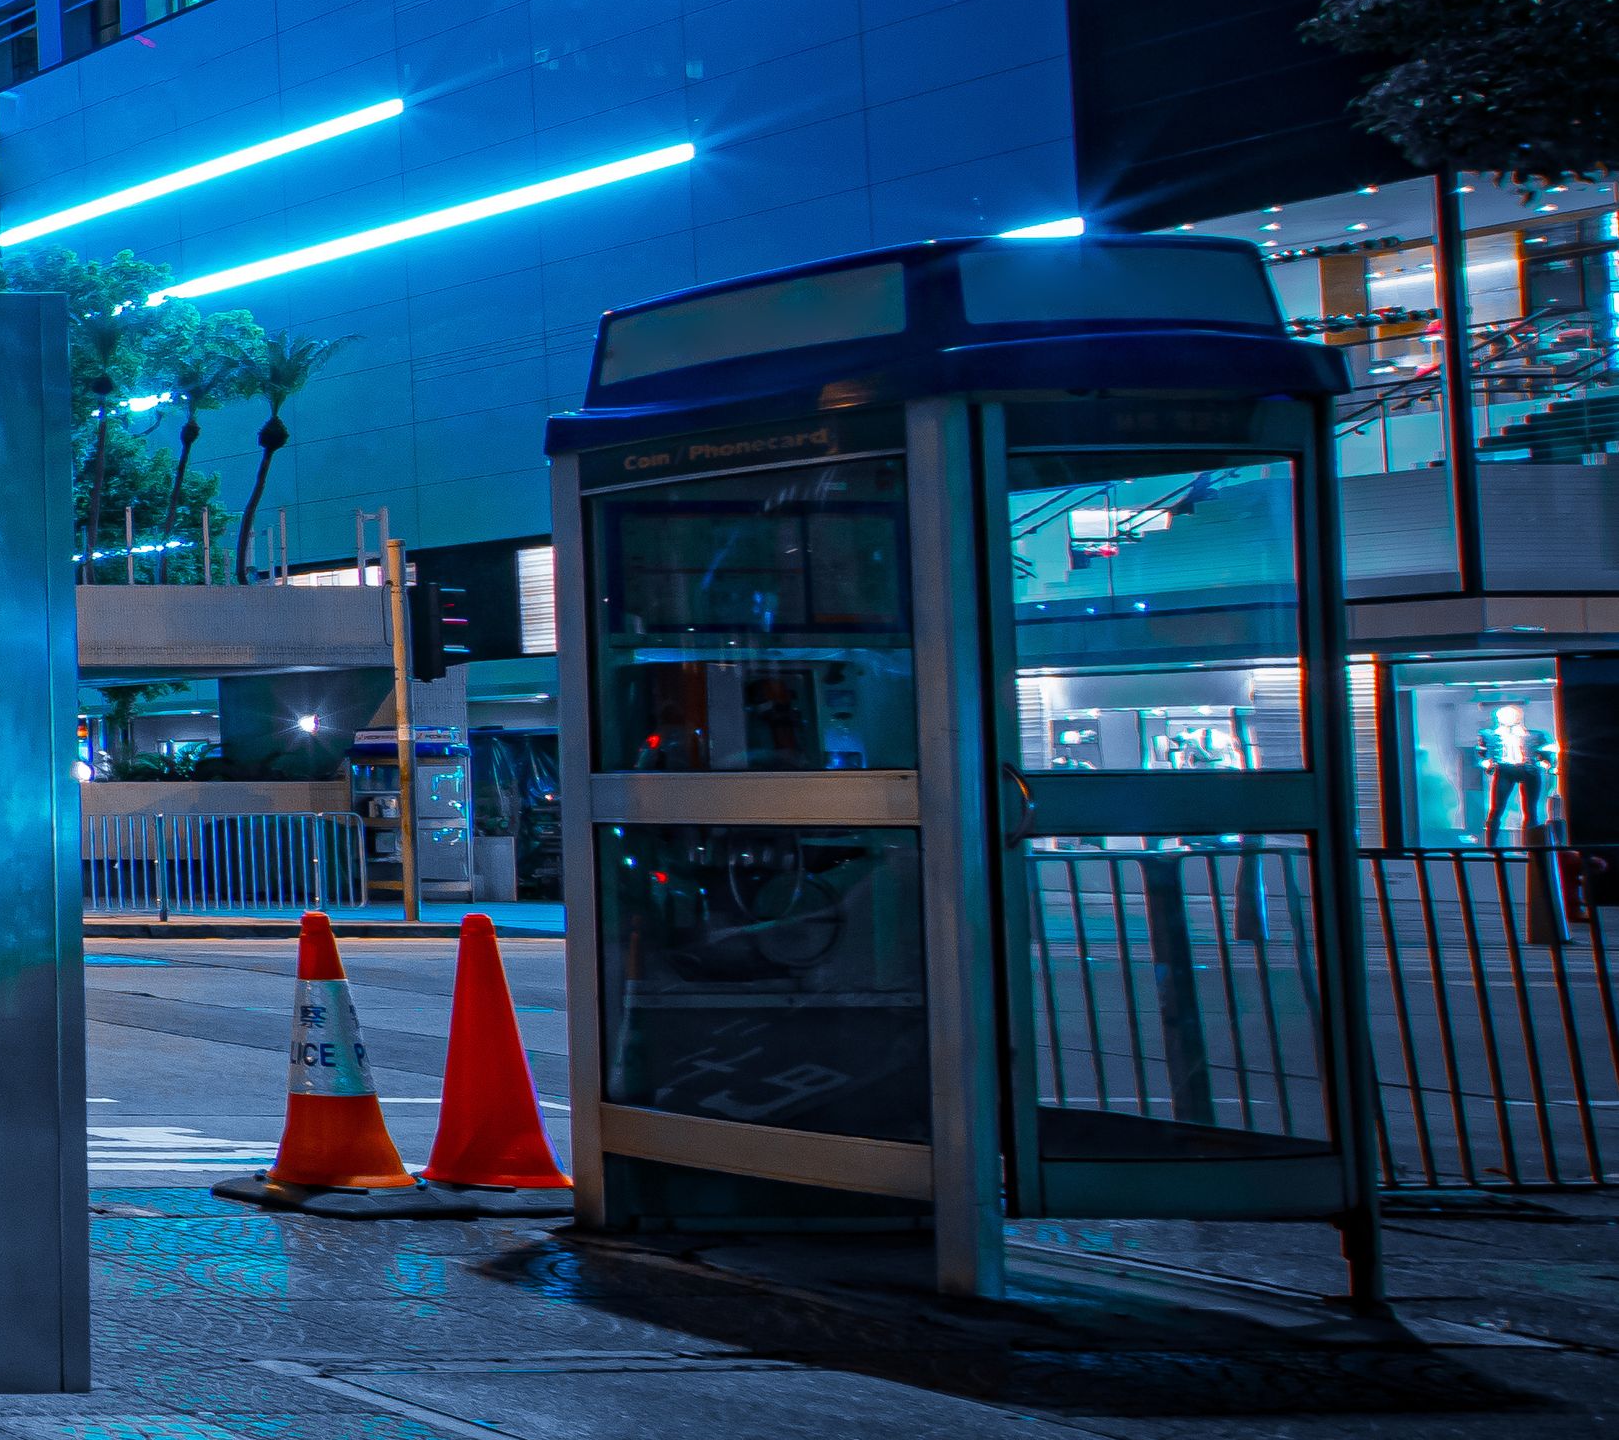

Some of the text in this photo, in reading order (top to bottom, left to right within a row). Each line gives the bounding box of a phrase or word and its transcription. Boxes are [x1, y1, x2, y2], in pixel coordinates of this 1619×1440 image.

[622, 451, 671, 471] Coin
[688, 428, 830, 460] Phonecard
[299, 1005, 327, 1029] 察
